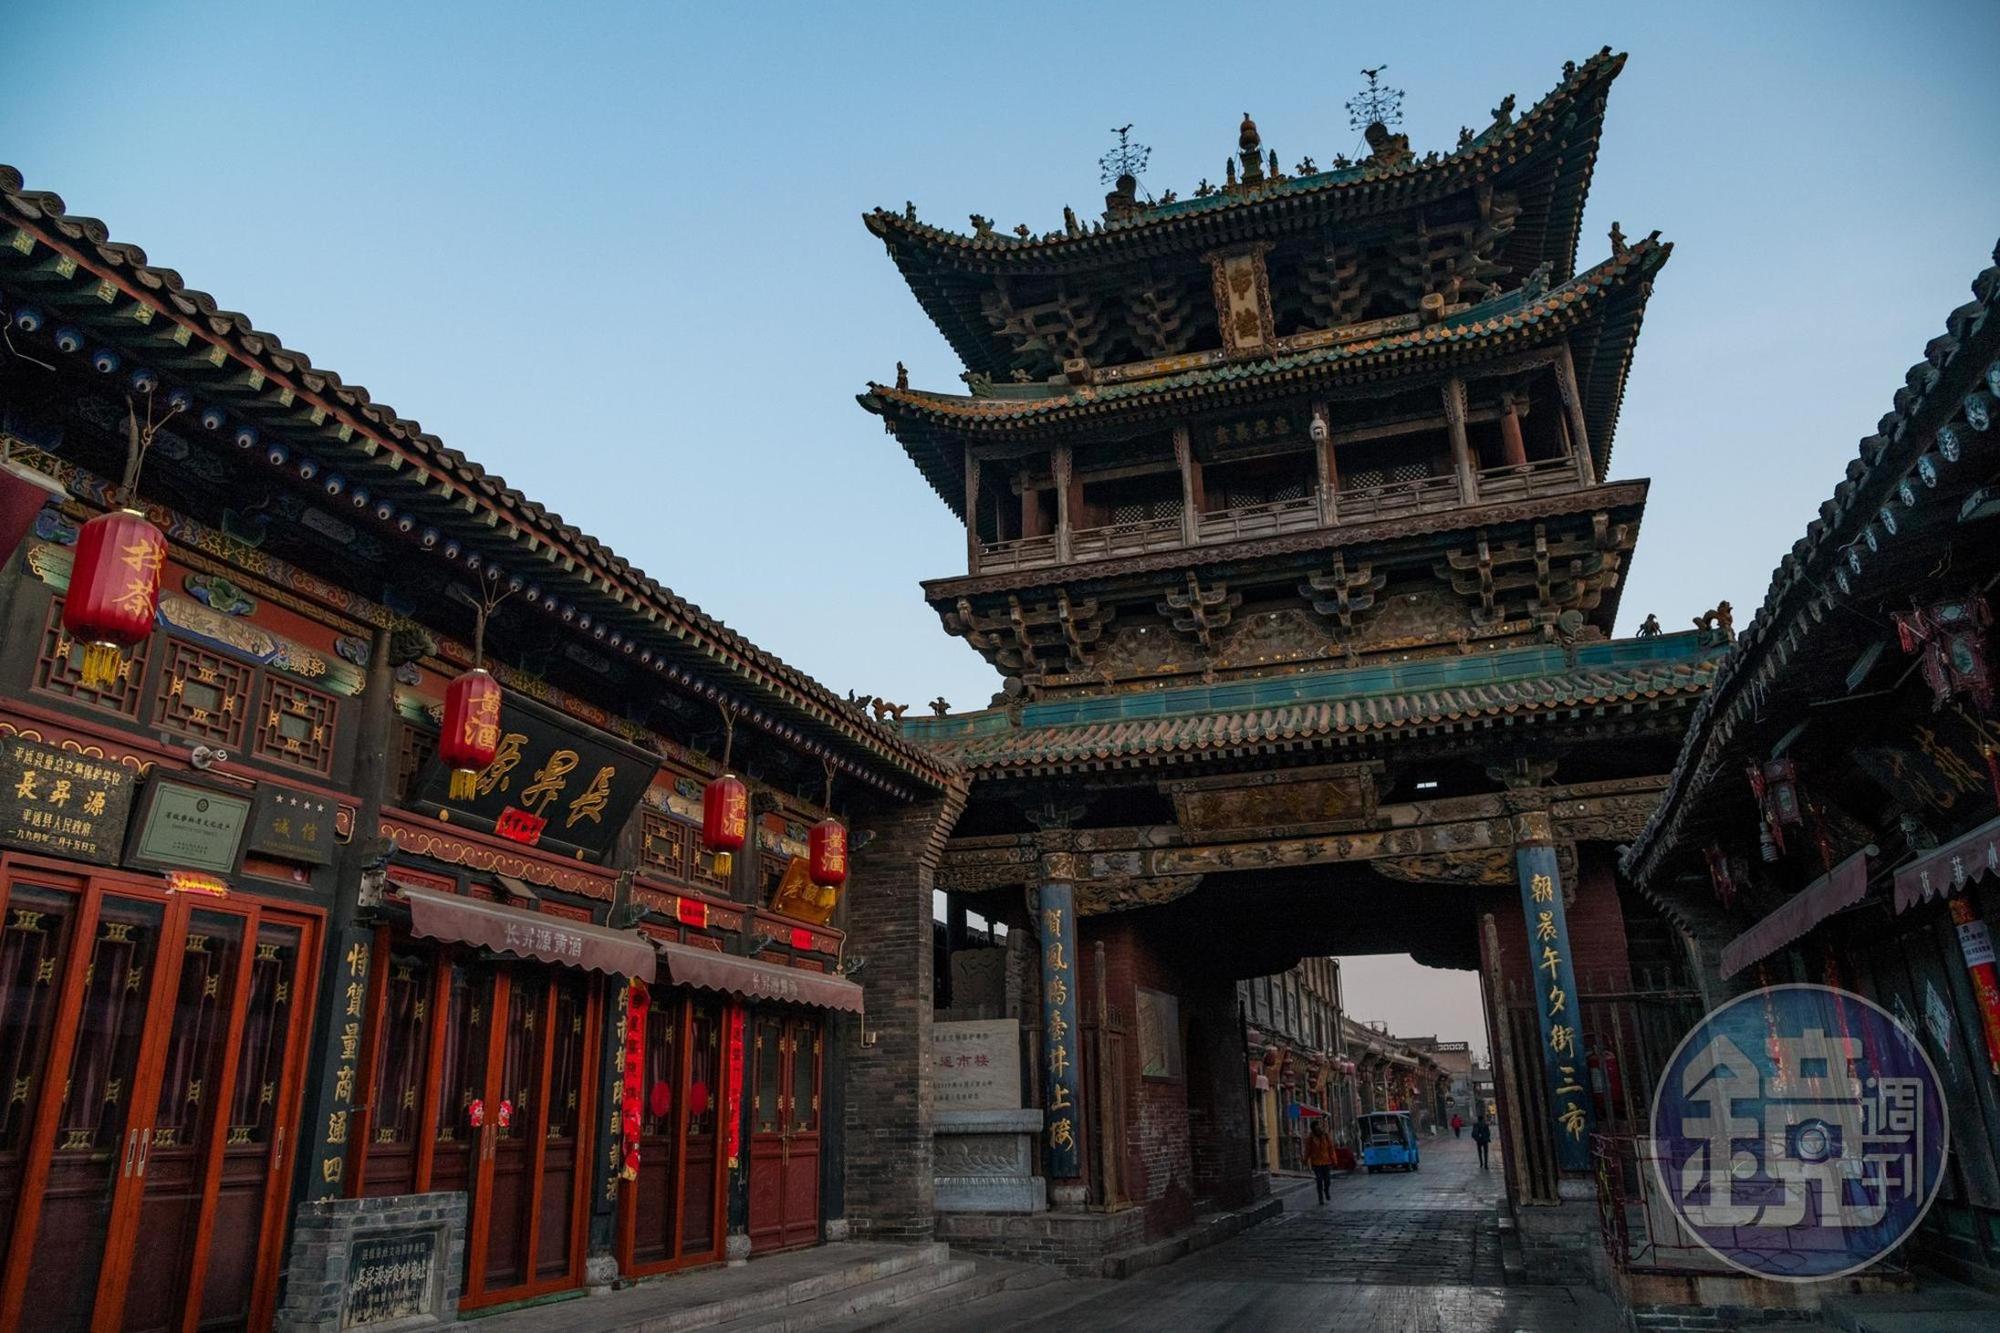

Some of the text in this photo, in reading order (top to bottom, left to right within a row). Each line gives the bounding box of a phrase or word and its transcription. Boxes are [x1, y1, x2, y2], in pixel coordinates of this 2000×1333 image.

[821, 832, 846, 873] 黄酒
[1530, 873, 1587, 1142] 朝晨午夕街三市
